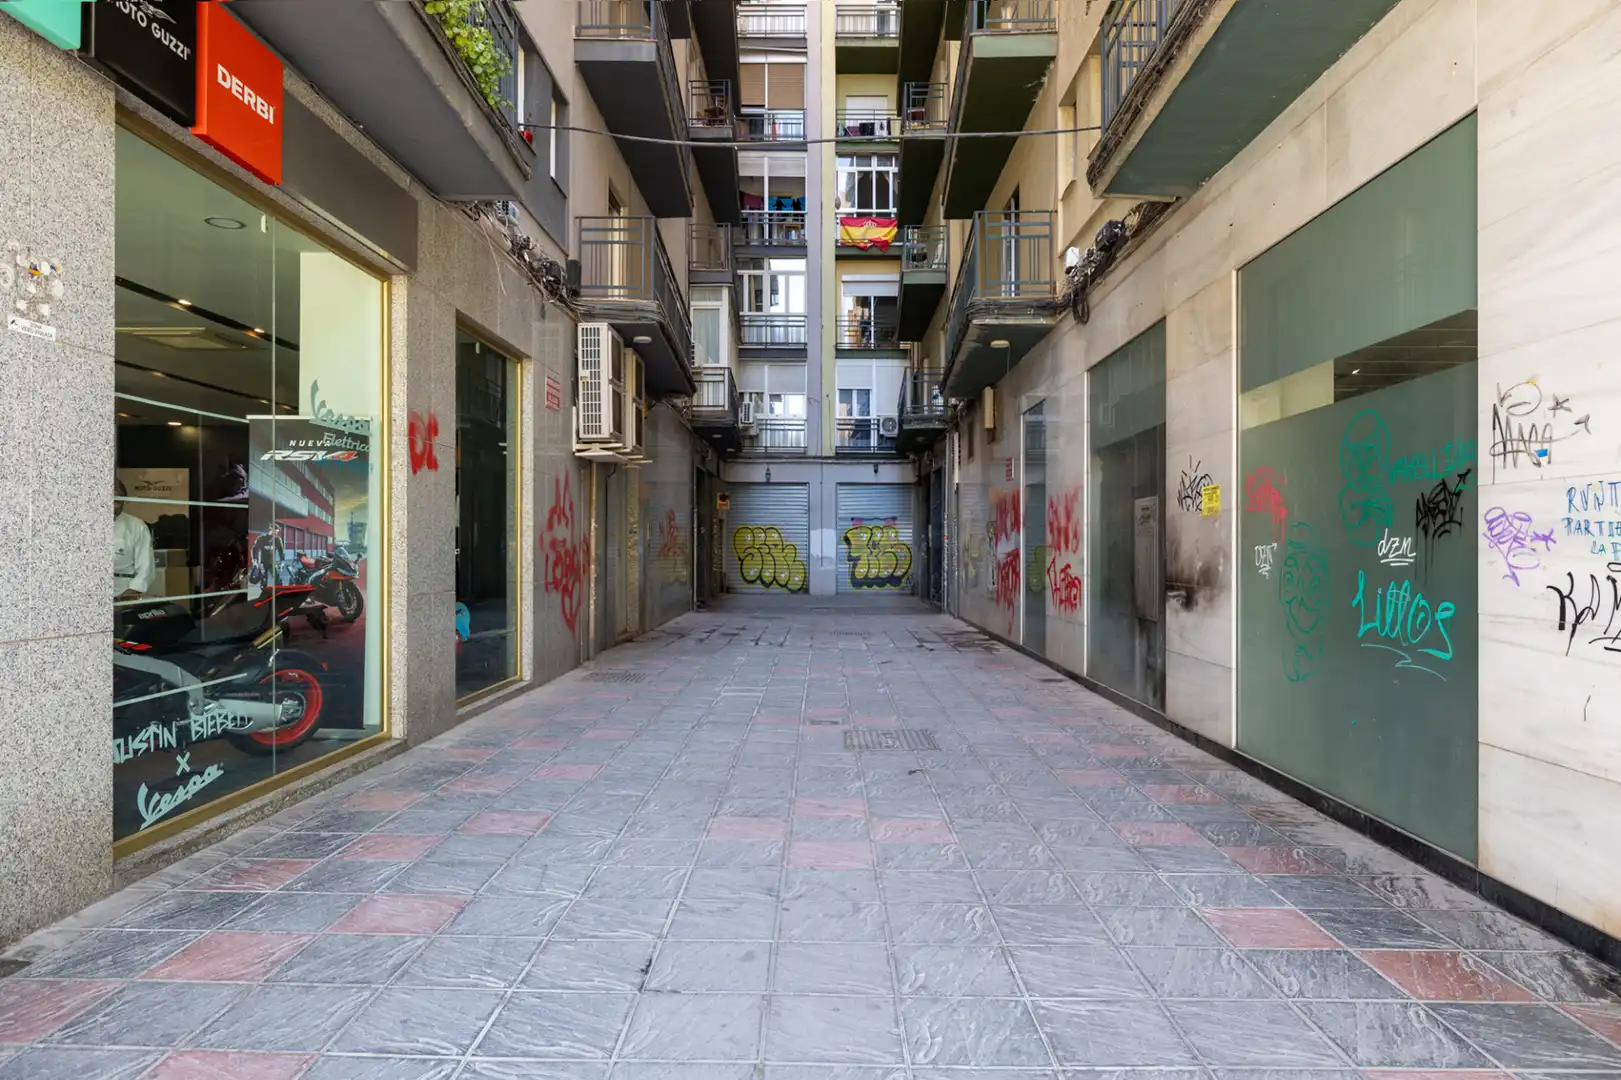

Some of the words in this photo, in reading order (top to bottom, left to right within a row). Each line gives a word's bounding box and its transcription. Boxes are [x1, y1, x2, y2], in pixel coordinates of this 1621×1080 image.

[107, 0, 147, 28] OTO
[151, 22, 188, 60] GUZZI
[216, 63, 275, 124] DERBI
[288, 439, 331, 447] NUEVA
